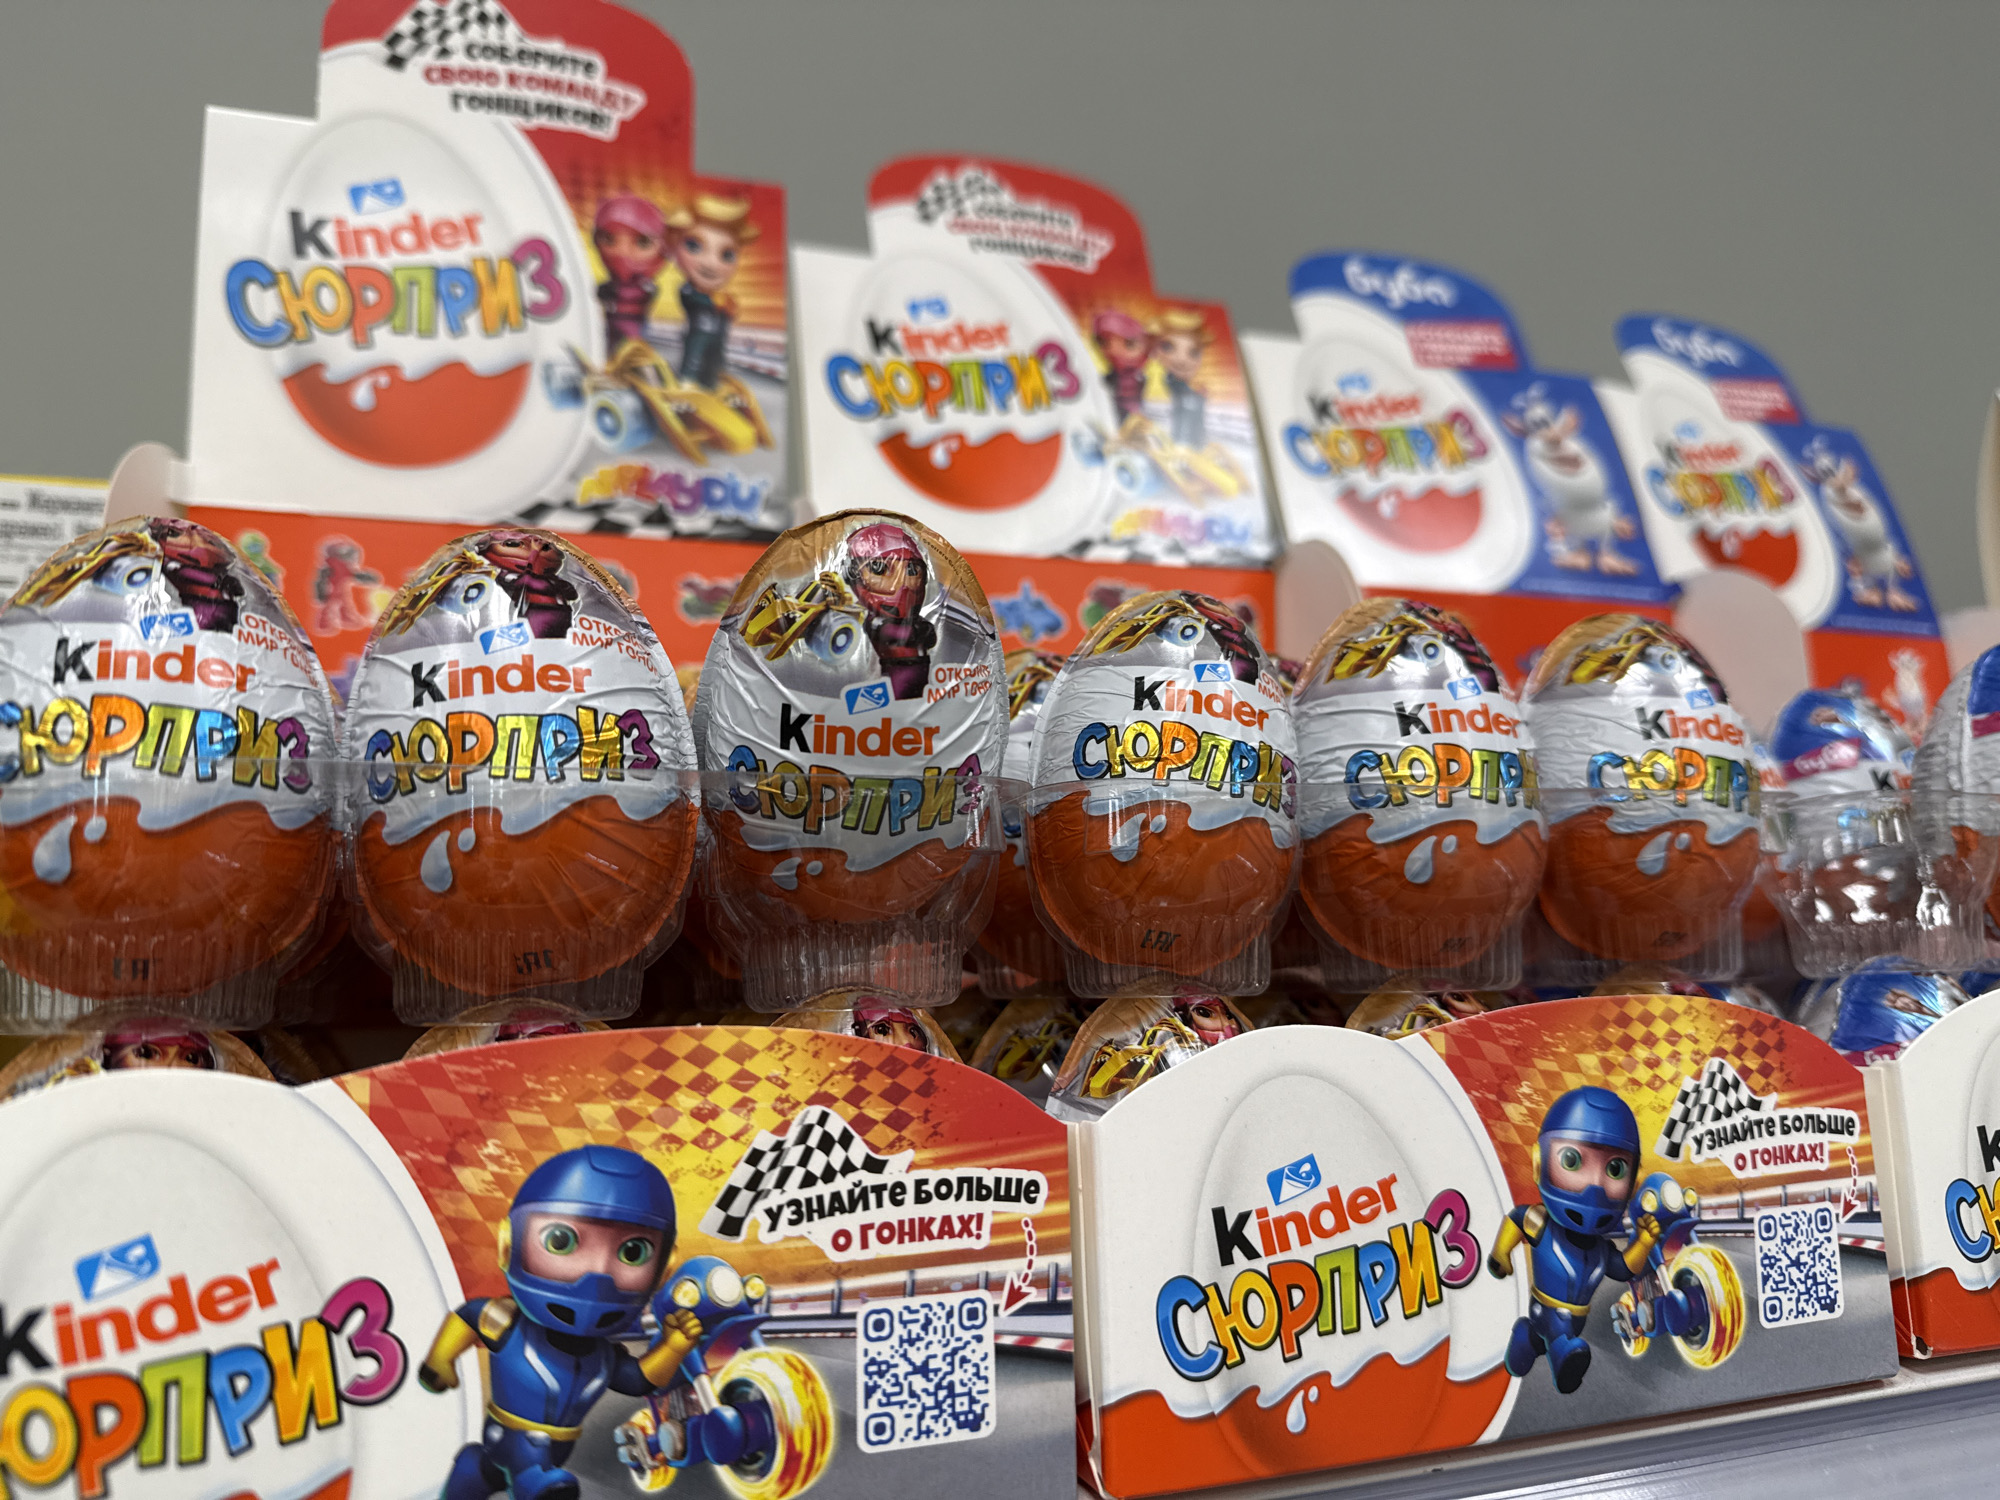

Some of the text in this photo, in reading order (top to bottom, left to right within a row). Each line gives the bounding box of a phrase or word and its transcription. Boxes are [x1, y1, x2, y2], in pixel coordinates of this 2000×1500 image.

[225, 236, 571, 350] СЮРПРИЗ
[824, 341, 1083, 422] СЮРПРИЗ
[238, 629, 279, 653] МИР
[573, 632, 614, 650] МИР
[364, 705, 661, 805] СЮРПРИЗ
[727, 744, 984, 837] СЮРПРИЗ
[1072, 720, 1298, 820] СЮРПРИЗ
[1751, 1141, 1825, 1170] ГОНКАХ!
[859, 1212, 984, 1251] ГОНКАХ!
[1156, 1188, 1482, 1382] СЮРПРИЗ
[0, 1276, 408, 1500] ЮРПРИЗ
